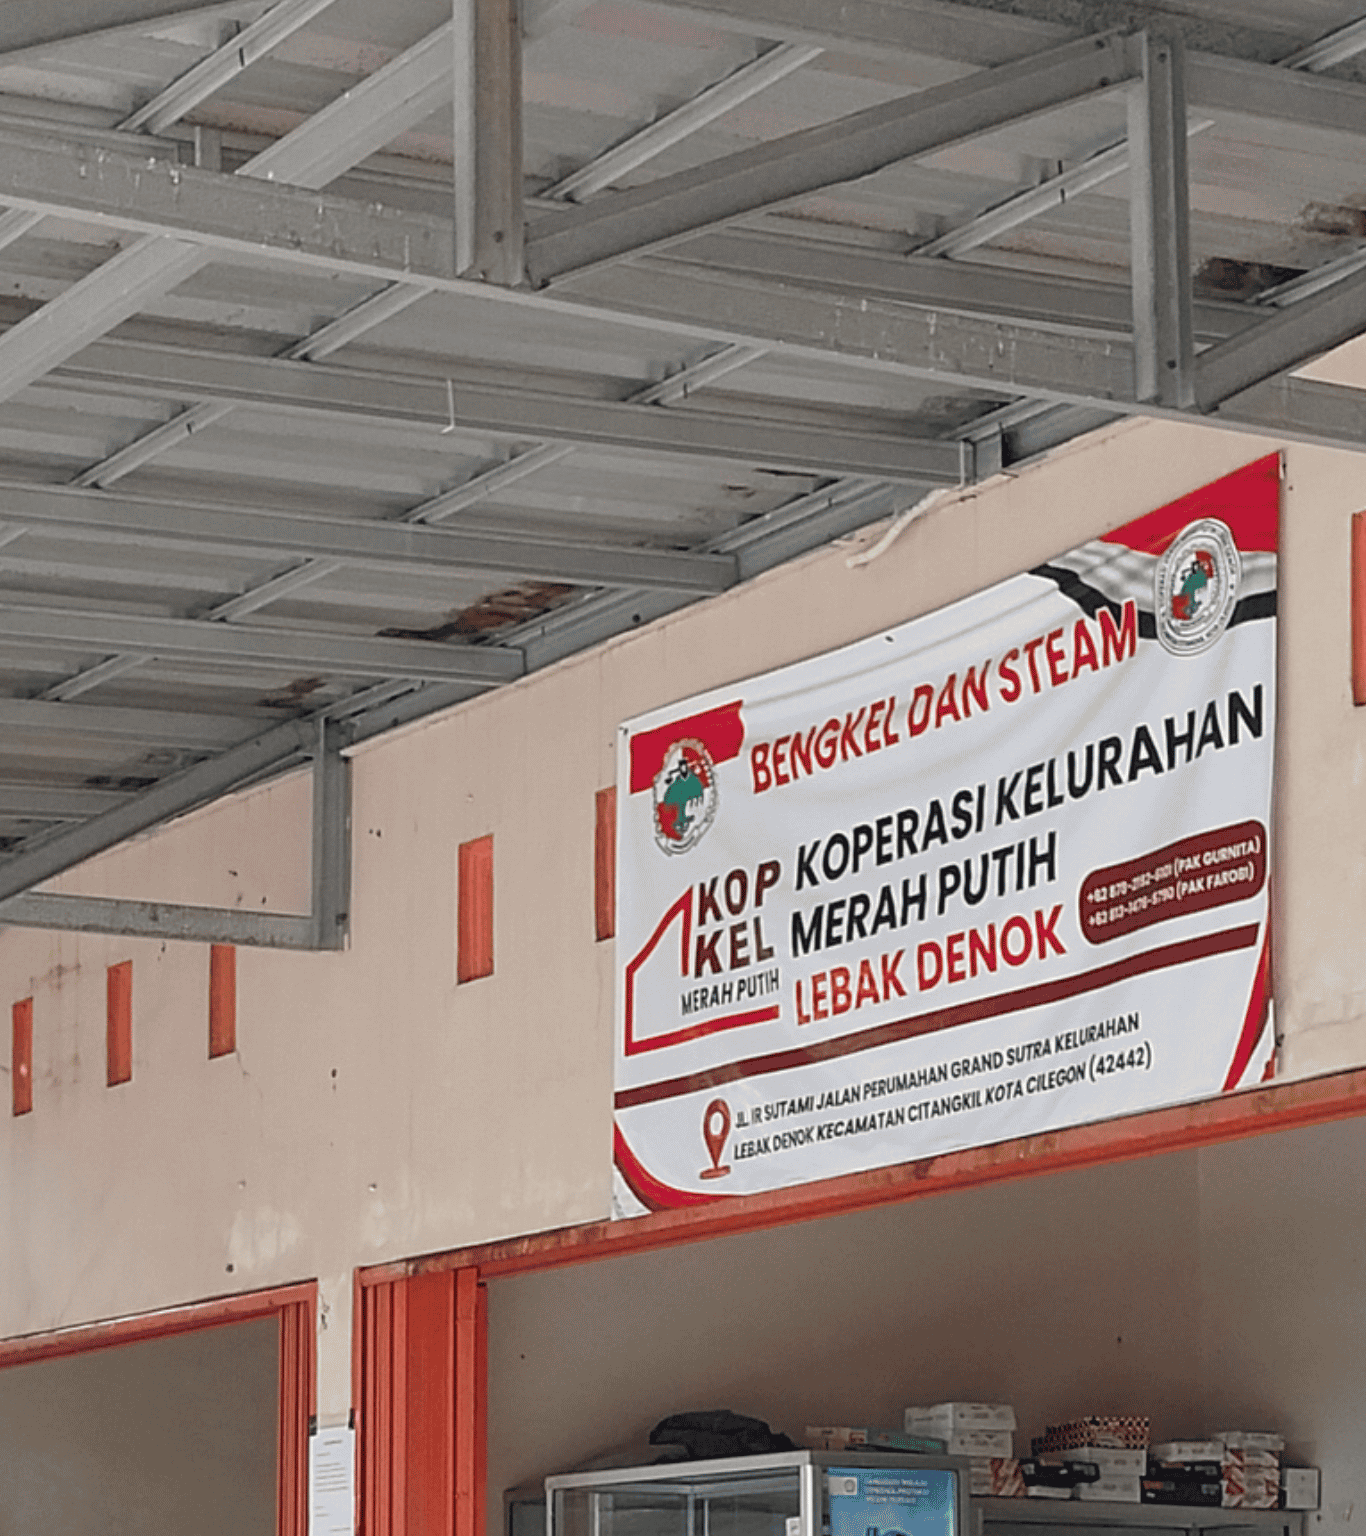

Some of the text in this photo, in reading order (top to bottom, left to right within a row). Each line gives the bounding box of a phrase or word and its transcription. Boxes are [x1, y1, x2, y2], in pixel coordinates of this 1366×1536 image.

[750, 599, 1137, 794] BENGKEL DAN STEAM
[795, 683, 1263, 891] KOPERASI KELURAHAN
[697, 859, 781, 927] KOP
[791, 830, 1057, 958] MERAH PUTIH
[1173, 854, 1201, 878] (PAK
[1176, 877, 1205, 900] (PAK
[681, 967, 779, 1016] MERAH PUTIH
[694, 915, 775, 979] KEL
[795, 904, 1068, 1026] LEBAK DENOK
[734, 1040, 1153, 1161] LEBAK DENOK KECAMATAN CITANGKIL KOTA CILEGON (42442)
[764, 1095, 814, 1122] SUTAMI
[816, 1083, 861, 1110] JALAN
[863, 1062, 948, 1101] PERUMAHAN
[951, 1051, 1004, 1079] GRAND
[1006, 1038, 1052, 1066] SUTRA
[1054, 1012, 1139, 1053] KELURAHAN
